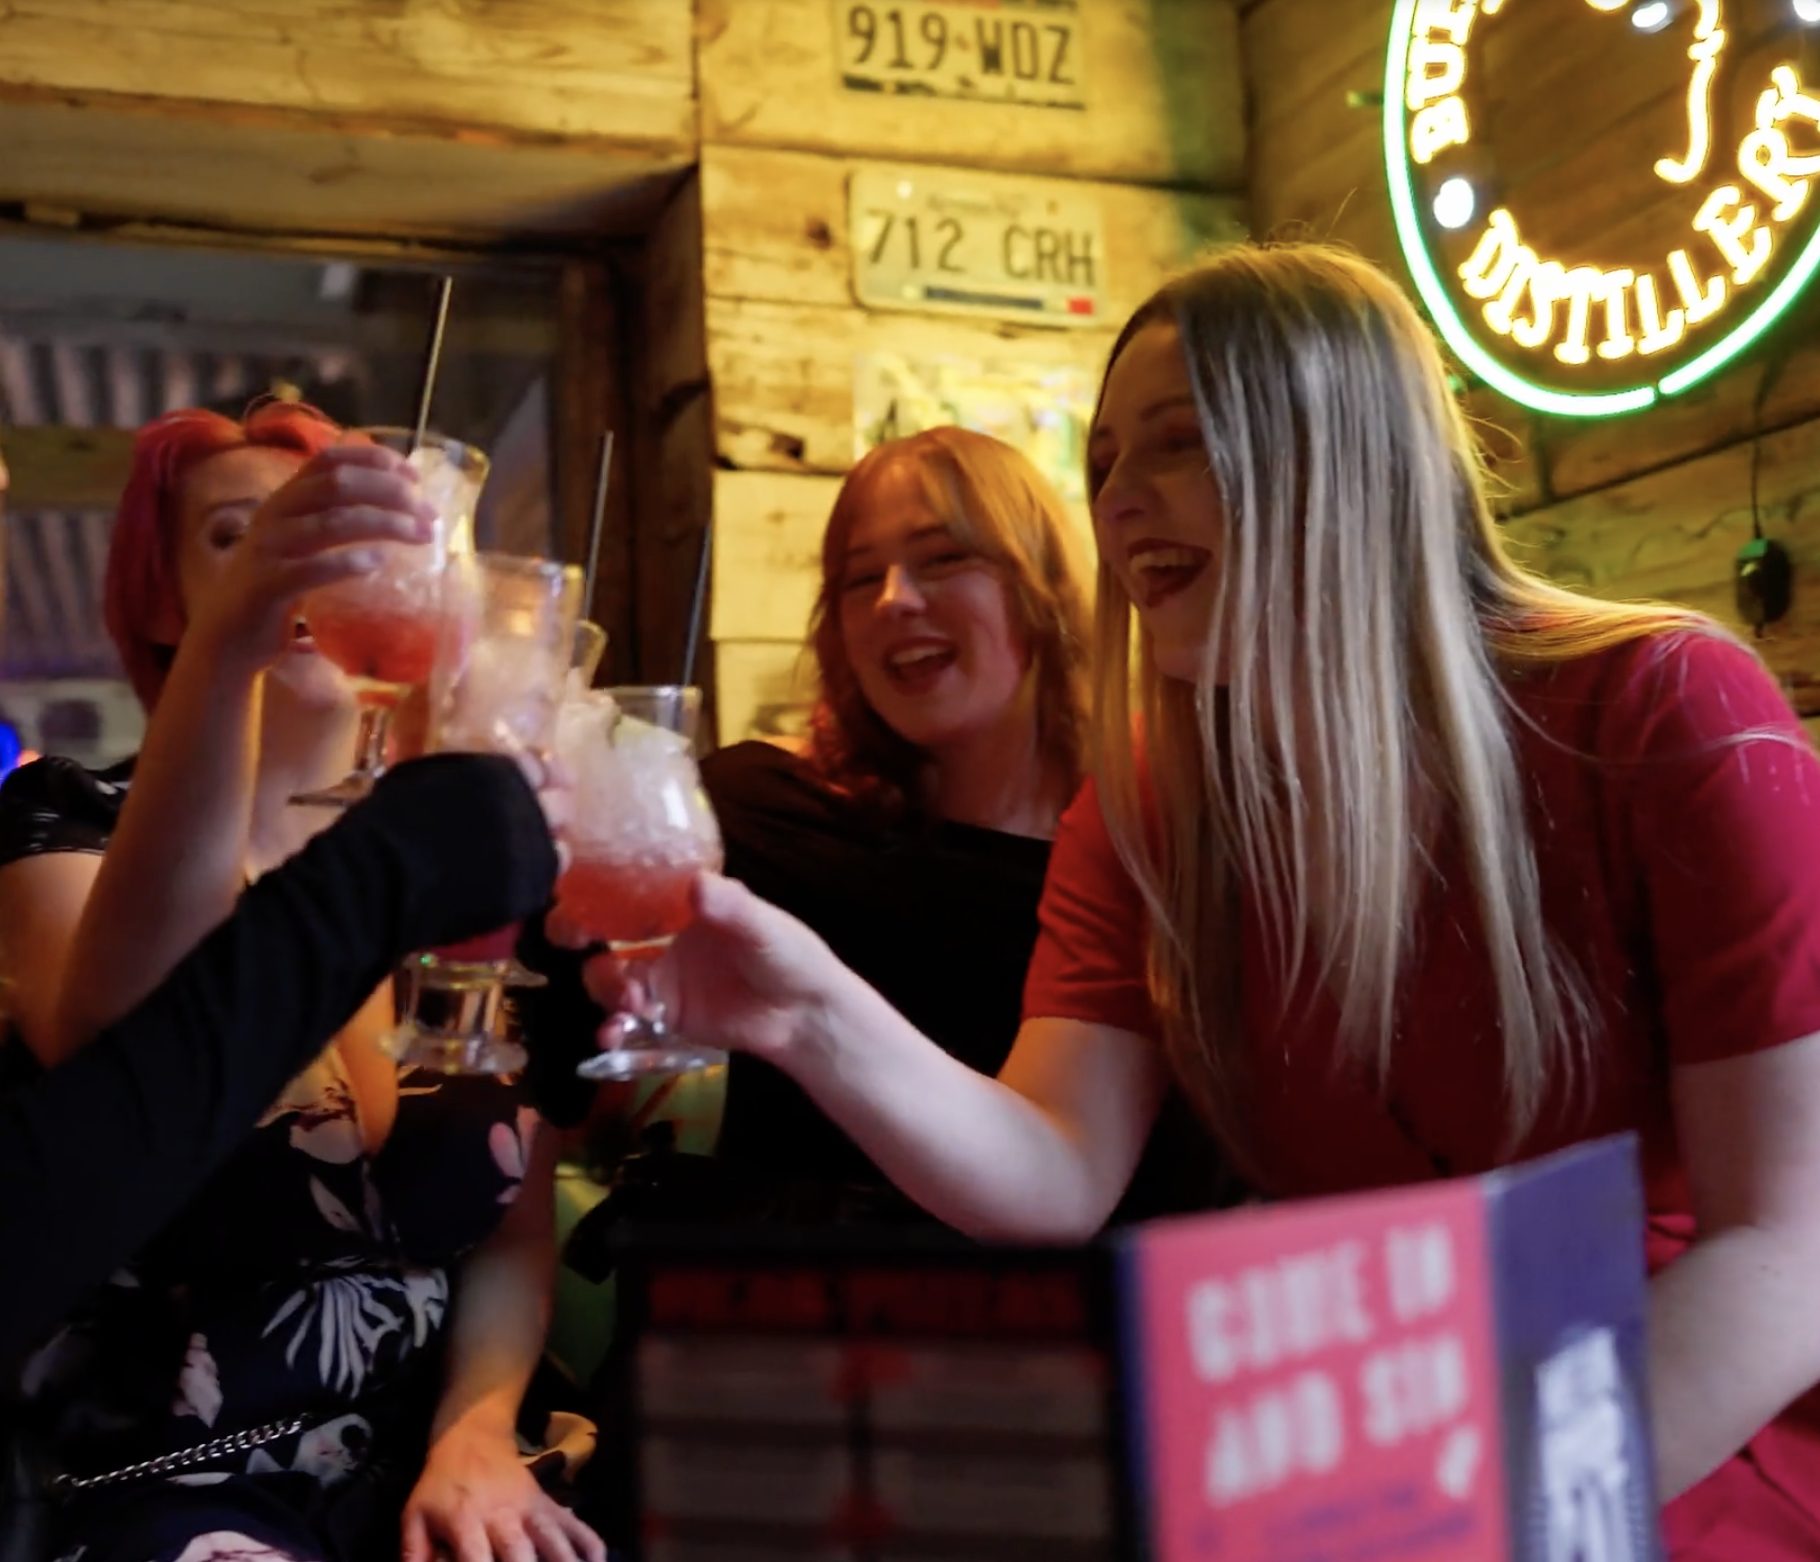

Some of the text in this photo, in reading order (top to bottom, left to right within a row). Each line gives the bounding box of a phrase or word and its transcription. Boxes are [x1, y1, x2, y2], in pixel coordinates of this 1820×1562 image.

[849, 5, 948, 71] 919
[864, 207, 1094, 287] 712 CRH
